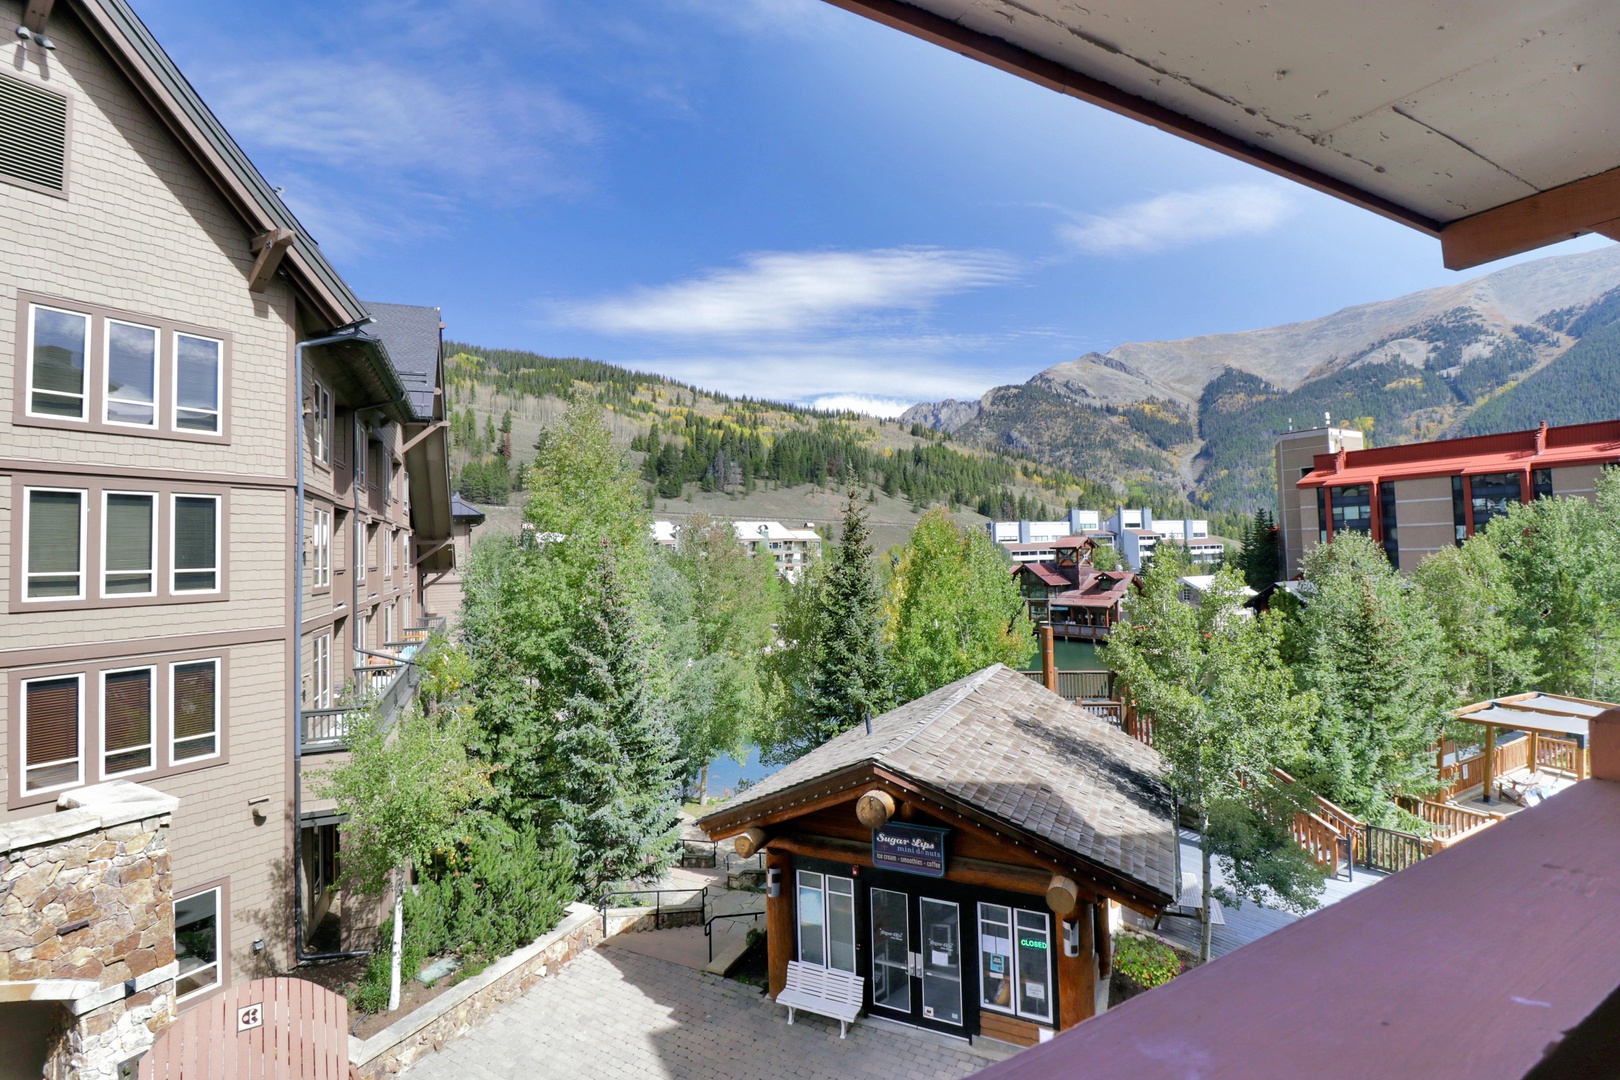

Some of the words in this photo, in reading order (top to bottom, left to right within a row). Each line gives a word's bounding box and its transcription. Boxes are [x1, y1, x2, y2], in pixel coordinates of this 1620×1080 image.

[876, 832, 909, 846] Sugar
[911, 838, 935, 850] Lips
[916, 848, 941, 858] donuts
[900, 857, 923, 866] smoothies
[926, 861, 941, 869] coffee
[1021, 939, 1048, 949] CLOSED
